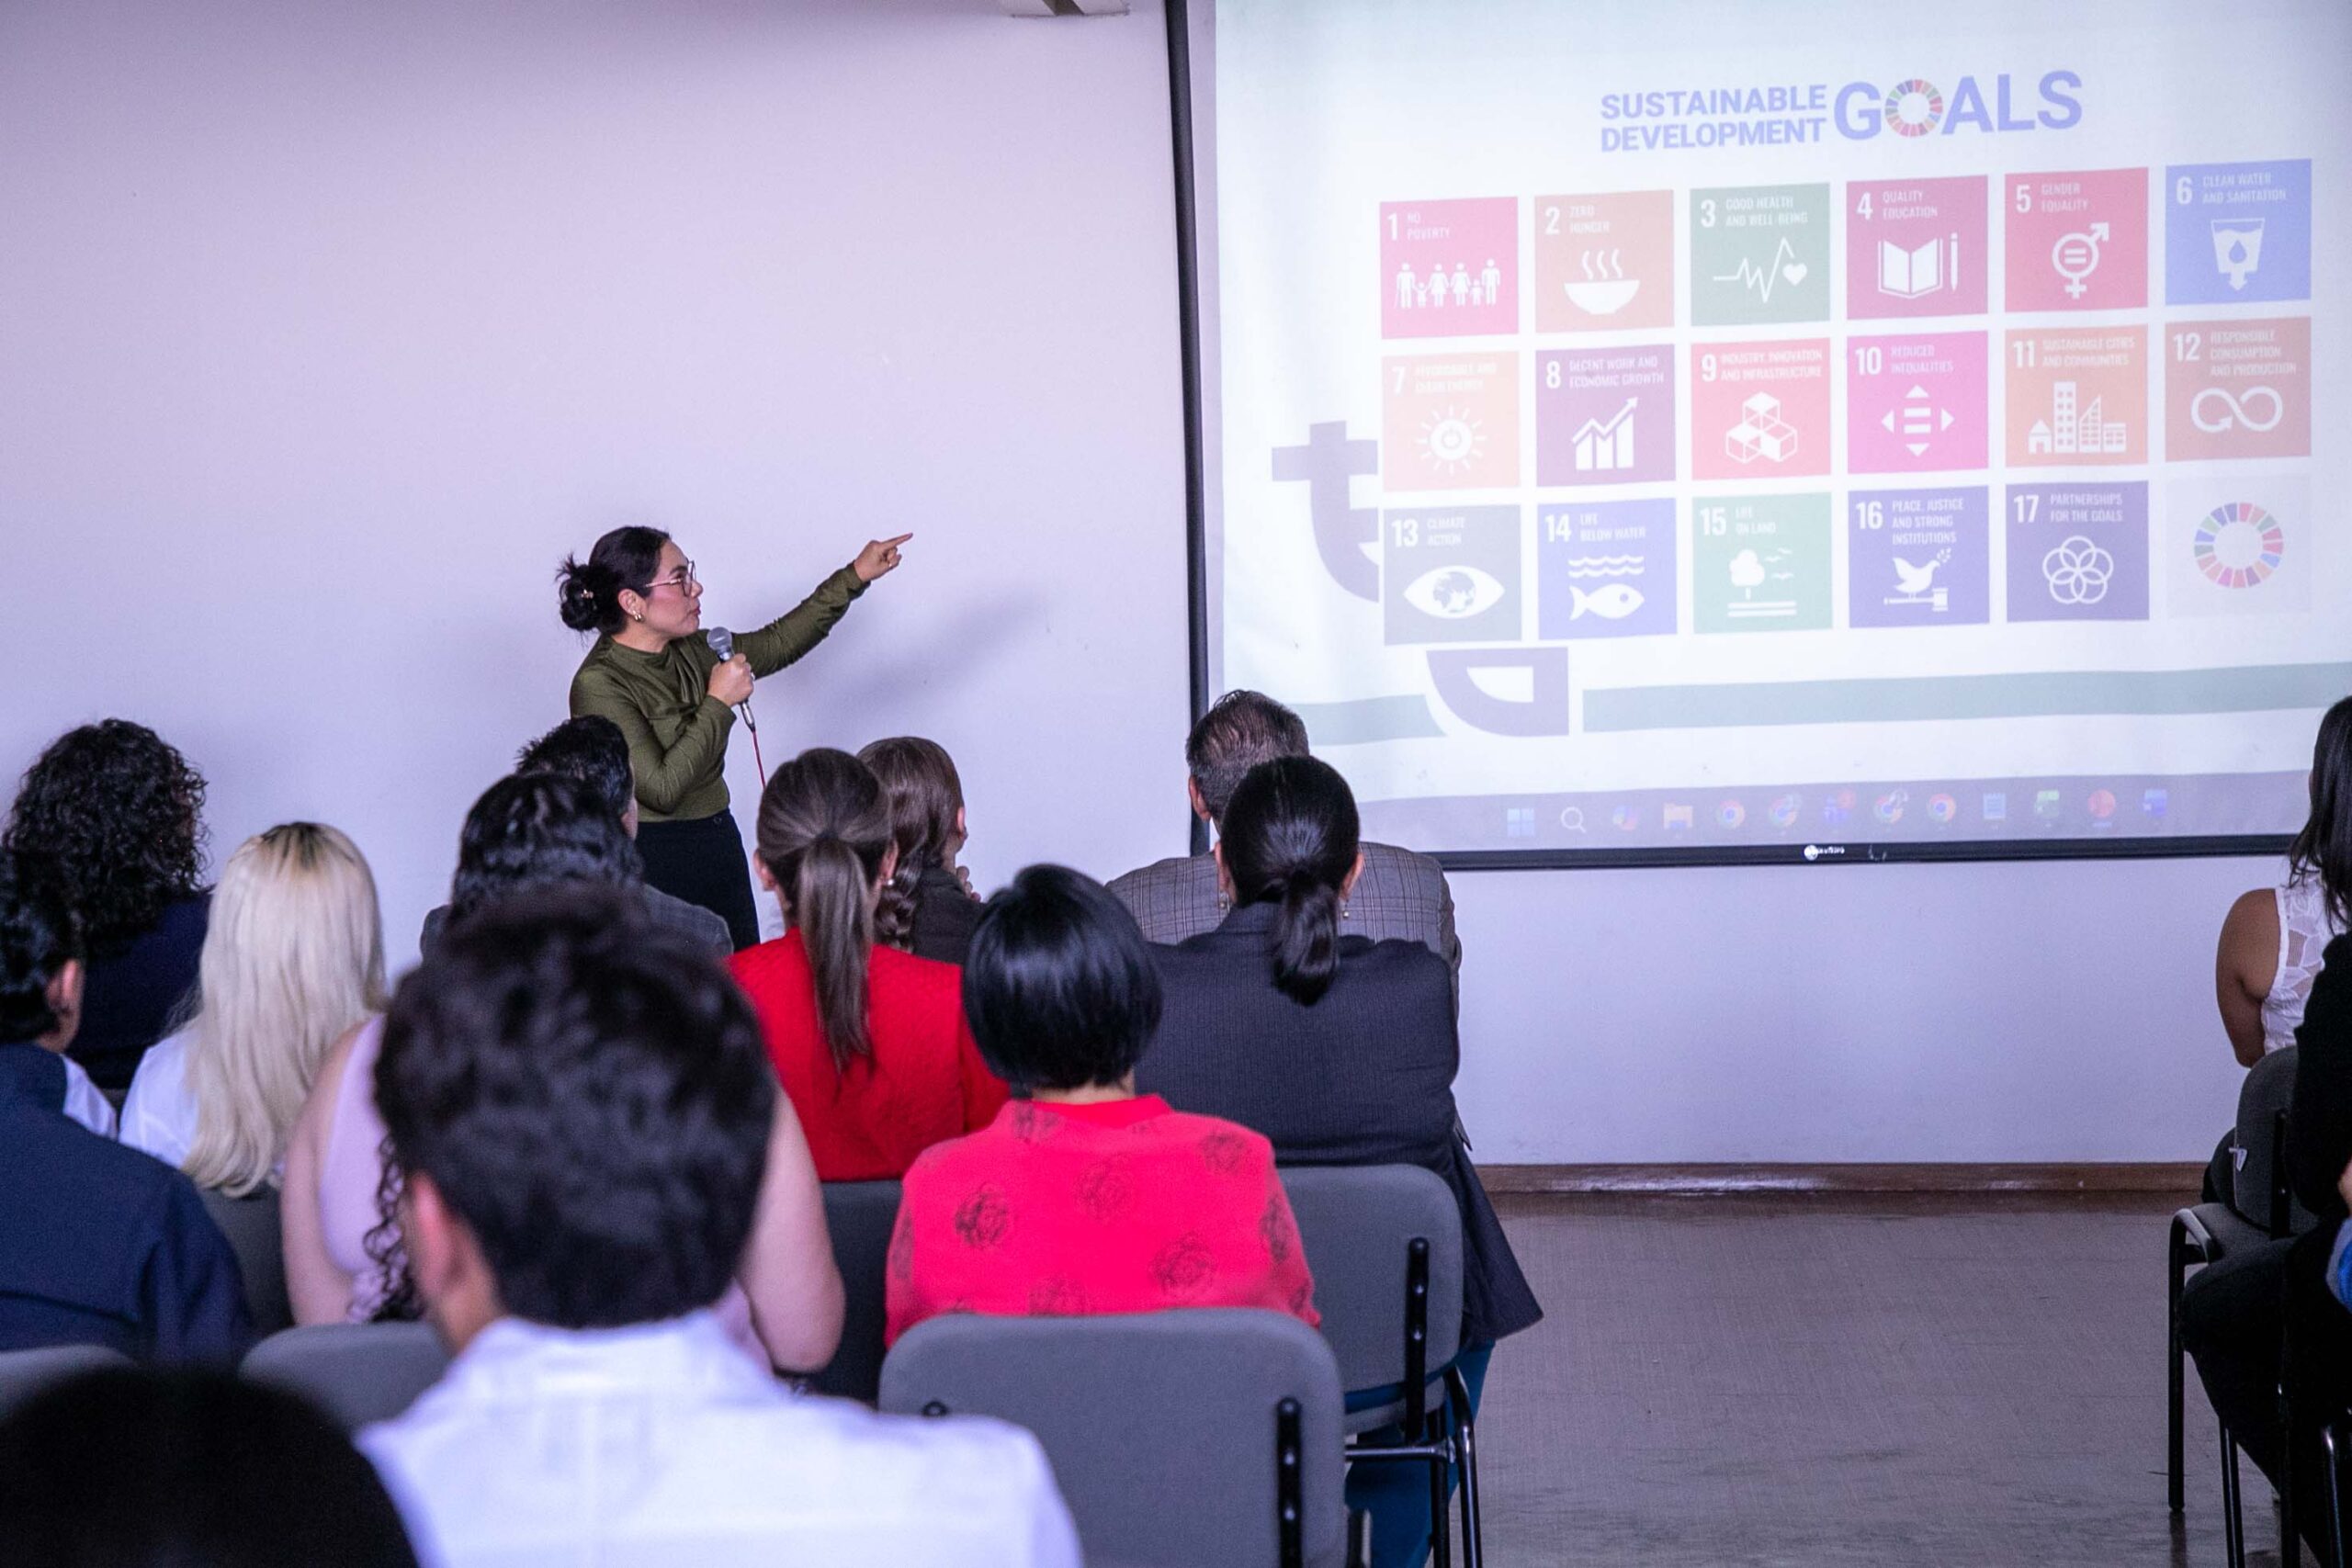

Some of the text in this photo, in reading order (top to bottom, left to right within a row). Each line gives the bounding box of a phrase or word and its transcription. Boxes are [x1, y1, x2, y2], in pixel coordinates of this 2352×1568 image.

[1600, 84, 1827, 120] SUSTAINABLE
[1834, 69, 2083, 141] GOALS
[1600, 117, 1826, 152] DEVELOPMENT
[1725, 196, 1793, 210] GOOD HEALTH
[1883, 190, 1923, 204] QUALITY
[2016, 184, 2031, 213] 5
[2177, 175, 2193, 205] 6
[1701, 198, 1716, 228] 3
[1857, 191, 1873, 220] 4
[1883, 206, 1939, 220] EDUCATION
[1387, 212, 1397, 241] 1
[1544, 206, 1560, 235] 2
[1725, 214, 1747, 226] AND
[1855, 346, 1882, 376] 10
[2013, 340, 2035, 368] 11
[2173, 333, 2201, 361] 12
[1546, 361, 1561, 389] 8
[1569, 358, 1604, 372] DECENT
[1638, 355, 1657, 367] AND
[1702, 354, 1716, 382] 9
[1721, 368, 1741, 381] AND
[1391, 366, 1406, 394] 7
[1569, 374, 1620, 389] ECONOMIC
[1927, 497, 1963, 511] JUSTICE
[2014, 494, 2039, 524] 17
[2051, 492, 2122, 505] PARTNERSHIPS
[1427, 516, 1464, 530] CLIMATE
[1545, 513, 1572, 542] 14
[1700, 506, 1726, 536] 15
[1855, 501, 1883, 529] 16
[1892, 514, 1953, 528] AND STRONG
[2051, 509, 2123, 523] FOR THE GOALS
[1391, 518, 1419, 548] 13
[1427, 533, 1462, 546] ACTION
[1580, 525, 1645, 542] BELOW WATER
[1892, 530, 1957, 545] INSTITUTIONS
